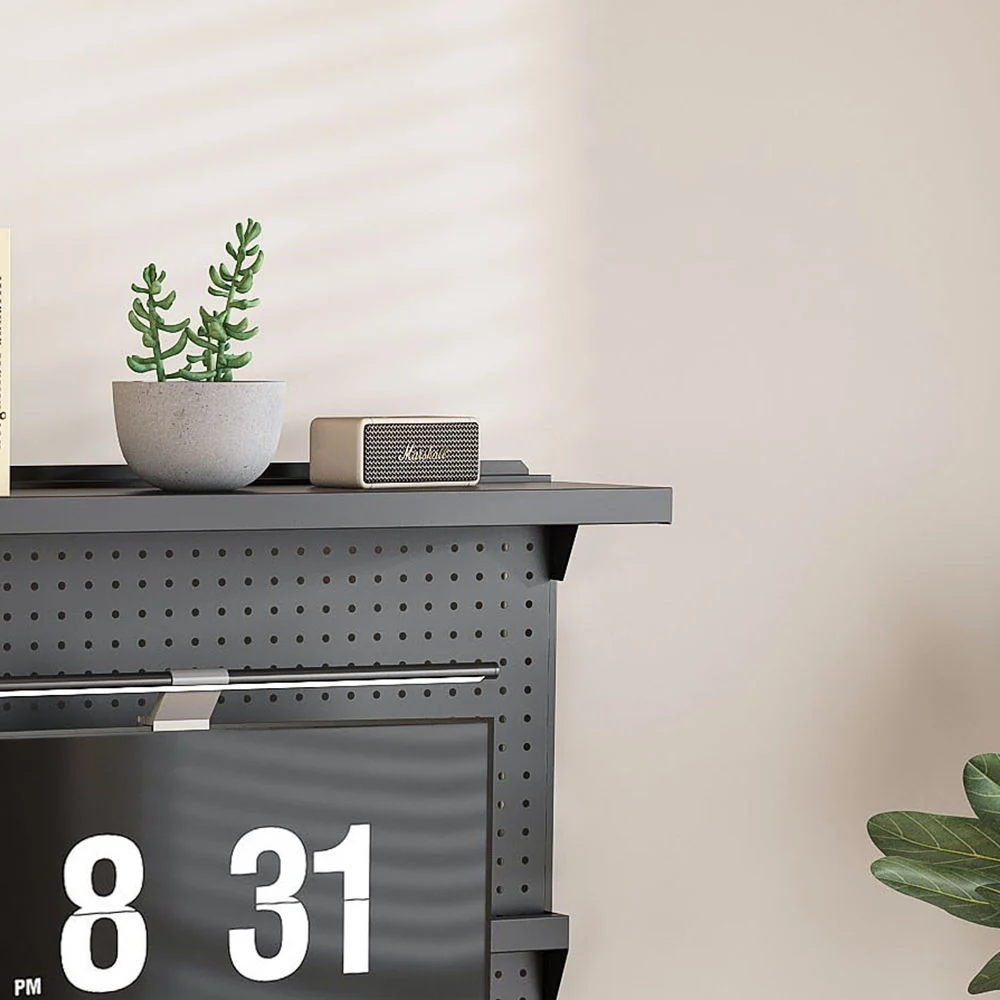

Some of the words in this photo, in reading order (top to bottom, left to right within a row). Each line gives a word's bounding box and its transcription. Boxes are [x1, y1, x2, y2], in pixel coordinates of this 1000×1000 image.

[60, 833, 147, 993] 8
[228, 823, 371, 982] 31
[14, 977, 42, 997] PM
